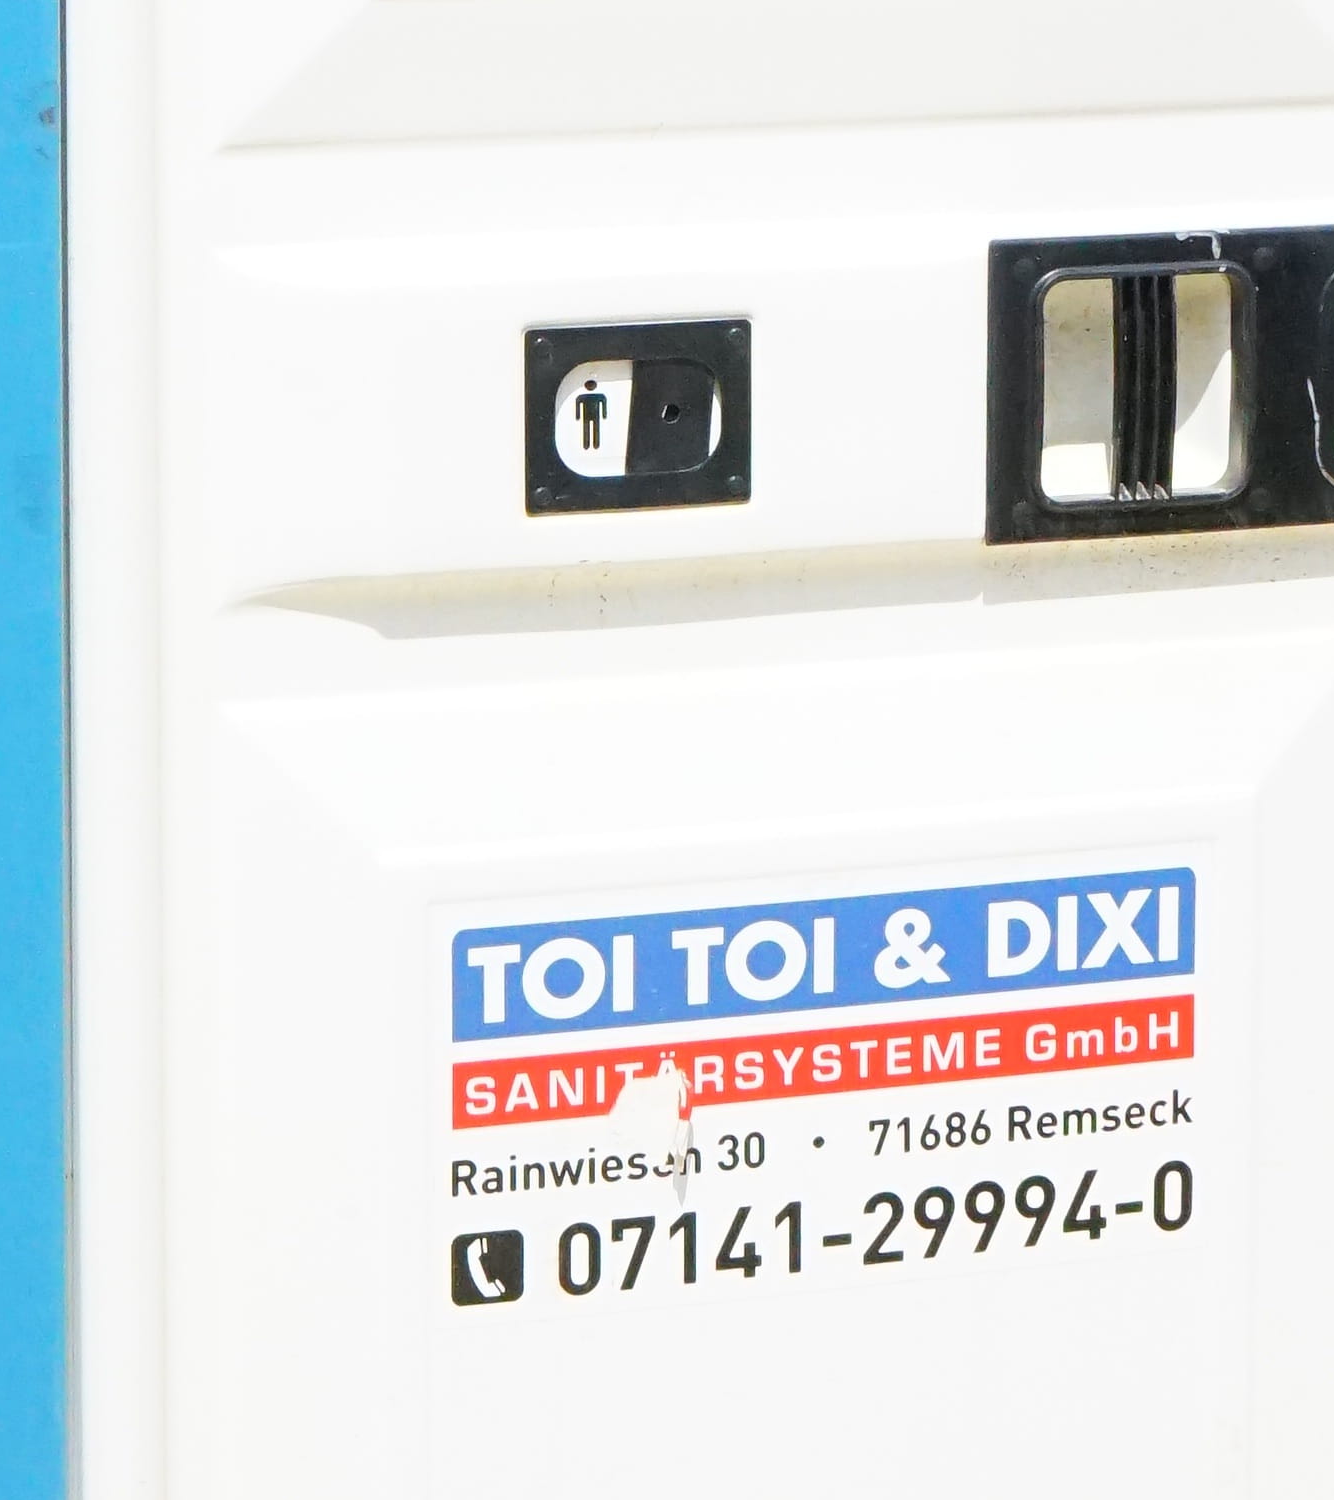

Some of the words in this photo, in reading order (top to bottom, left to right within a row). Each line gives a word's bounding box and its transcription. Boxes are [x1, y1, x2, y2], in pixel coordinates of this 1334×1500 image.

[467, 934, 634, 1025] TOI
[671, 917, 835, 1006] TOI
[874, 908, 951, 989] &
[987, 886, 1180, 979] DIXI
[1024, 1011, 1180, 1063] GmbH
[717, 1132, 766, 1171] 30
[869, 1110, 992, 1156] 71686
[1008, 1089, 1193, 1142] Remseck
[558, 1160, 1194, 1296] 07141-29994-0
